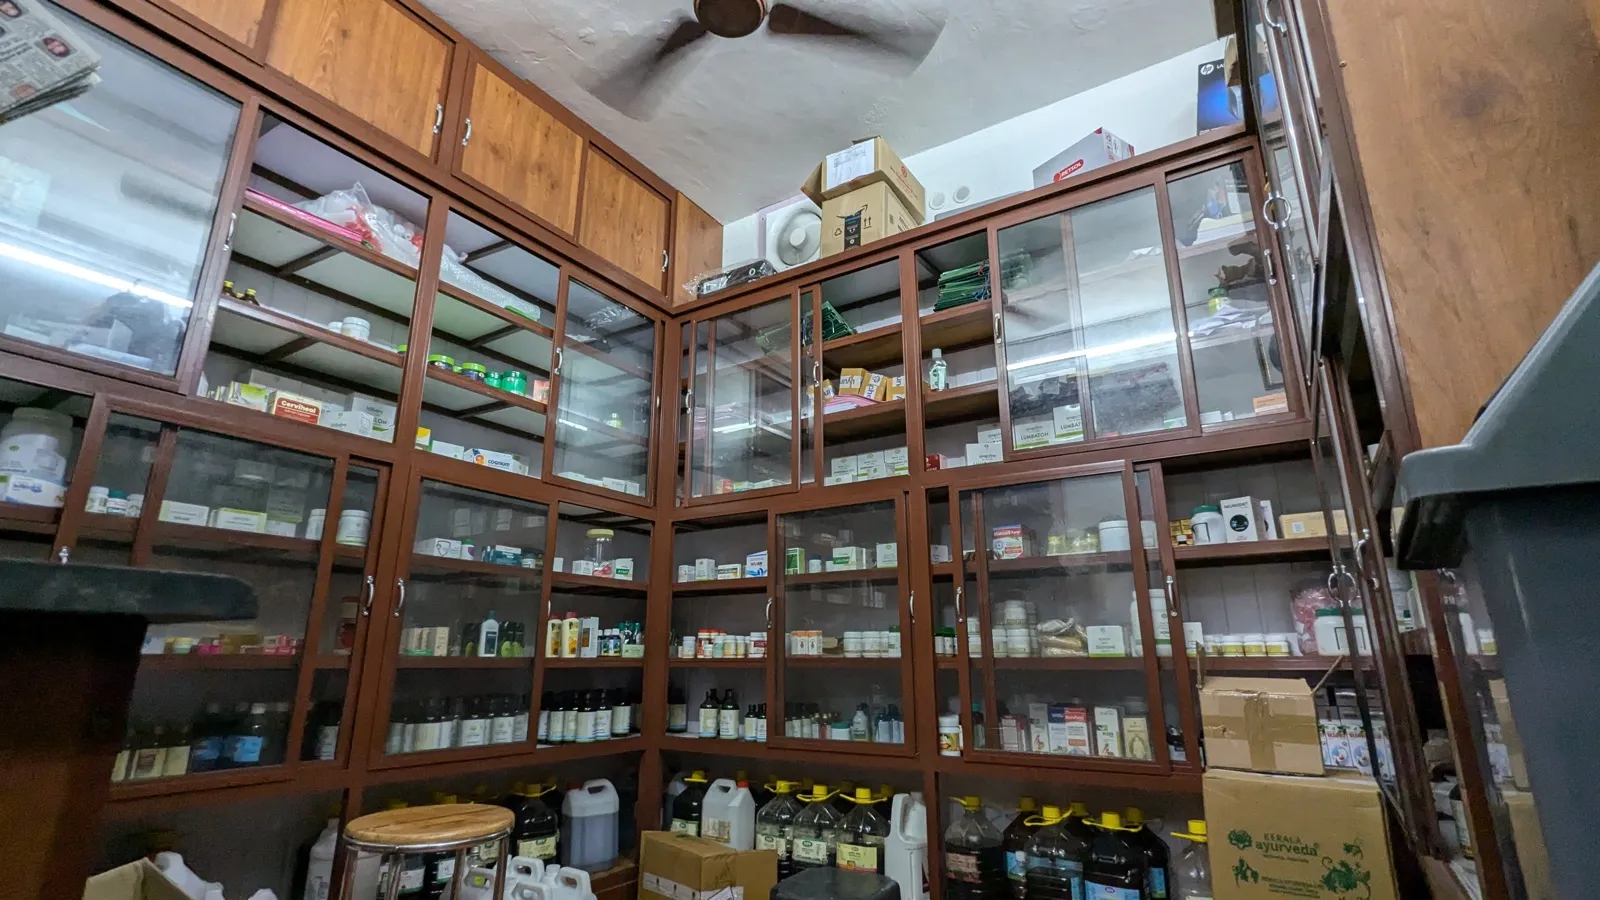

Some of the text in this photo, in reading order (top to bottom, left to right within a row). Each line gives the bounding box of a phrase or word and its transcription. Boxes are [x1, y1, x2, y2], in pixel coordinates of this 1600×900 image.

[281, 400, 317, 413] Cerviheal
[1060, 421, 1081, 430] LUMBAT
[1264, 832, 1302, 844] KERALA
[1255, 841, 1318, 857] ayurveda
